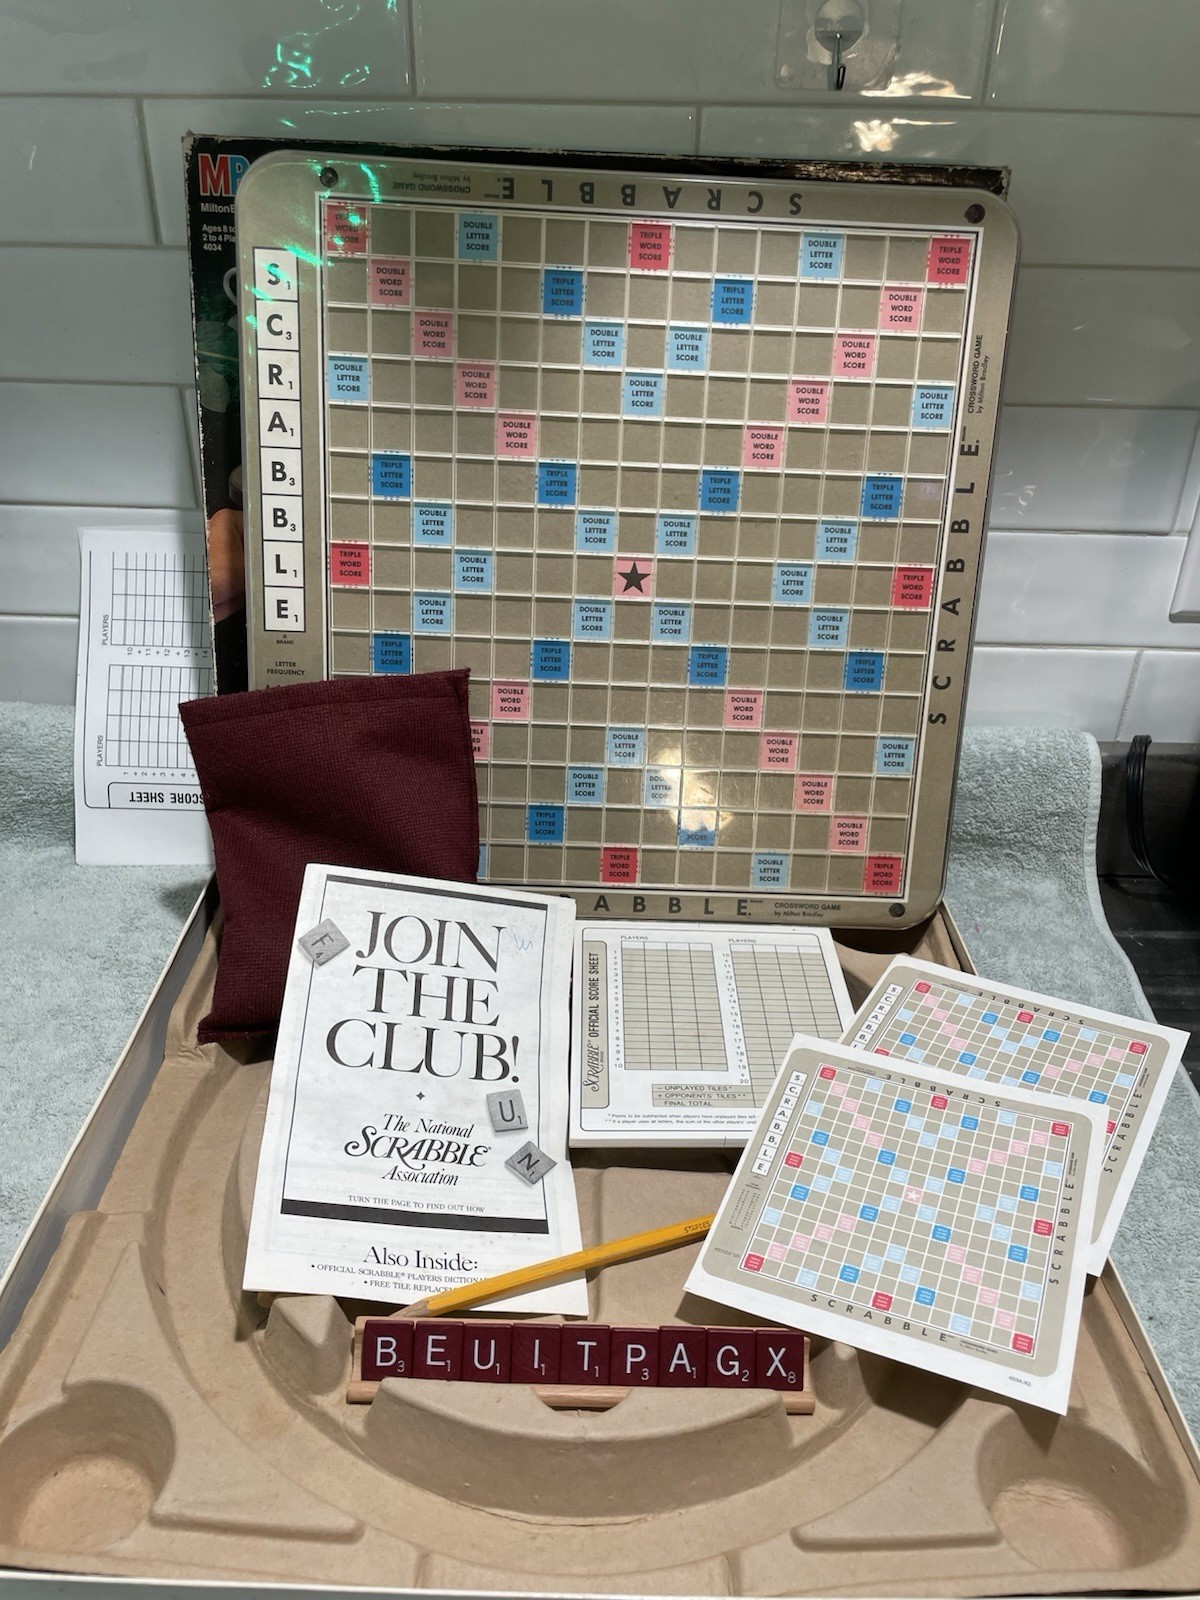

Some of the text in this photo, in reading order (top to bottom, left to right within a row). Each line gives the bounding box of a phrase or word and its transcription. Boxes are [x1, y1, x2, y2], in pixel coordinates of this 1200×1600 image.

[392, 181, 471, 194] CROSSWORD GAME
[202, 224, 222, 234] Ages
[463, 221, 493, 230] DOUBLE
[202, 233, 208, 242] 2
[208, 233, 217, 242] to
[218, 234, 223, 242] 4
[466, 232, 490, 240] LETTER
[639, 231, 663, 239] TRIPLE
[203, 242, 222, 251] 4034
[466, 243, 490, 251] SCORE
[638, 242, 663, 250] WORD
[939, 246, 962, 254] TRIPLE
[638, 253, 662, 261] SCORE
[938, 257, 961, 265] WORD
[936, 267, 961, 275] SCORE
[722, 286, 745, 294] TRIPLE
[721, 297, 745, 305] LETTER
[721, 307, 744, 315] SCORE
[674, 333, 703, 341] DOUBLE
[676, 354, 699, 362] SCORE
[333, 363, 363, 372] DOUBLE
[980, 354, 990, 381] Bradley
[336, 374, 361, 382] LETTER
[967, 334, 983, 414] CROSSWORD GAME
[336, 384, 361, 392] SCORE
[795, 386, 824, 395] DOUBLE
[977, 382, 985, 404] Milton
[798, 397, 821, 405] WORD
[797, 407, 820, 415] SCORE
[709, 476, 732, 485] TRIPLE
[419, 509, 447, 517] DOUBLE
[339, 550, 362, 558] TRIPLE
[339, 560, 362, 568] WORD
[102, 614, 110, 646] PLAYERS
[540, 646, 562, 654] TRIPLE
[266, 668, 306, 676] FREQUENCY
[96, 734, 104, 767] PLAYERS
[129, 791, 204, 804] SCORE SHEET
[774, 902, 820, 910] CROSSWORD
[355, 910, 507, 973] JOIN
[588, 952, 600, 975] SHEET
[588, 977, 600, 1001] SCORE
[352, 964, 500, 1027] THE
[588, 1004, 600, 1038] OFFICIAL
[325, 1018, 520, 1083] CLUB!
[384, 1113, 475, 1139] The National
[381, 1164, 459, 1186] Association
[348, 1194, 486, 1213] TURN THE PAGE TO FIND OUT HOW
[363, 1246, 479, 1272] Also Inside:
[316, 1263, 357, 1274] OFFICIAL
[407, 1272, 442, 1283] PLAYERS
[369, 1280, 391, 1289] FREE
[392, 1282, 412, 1290] TILE
